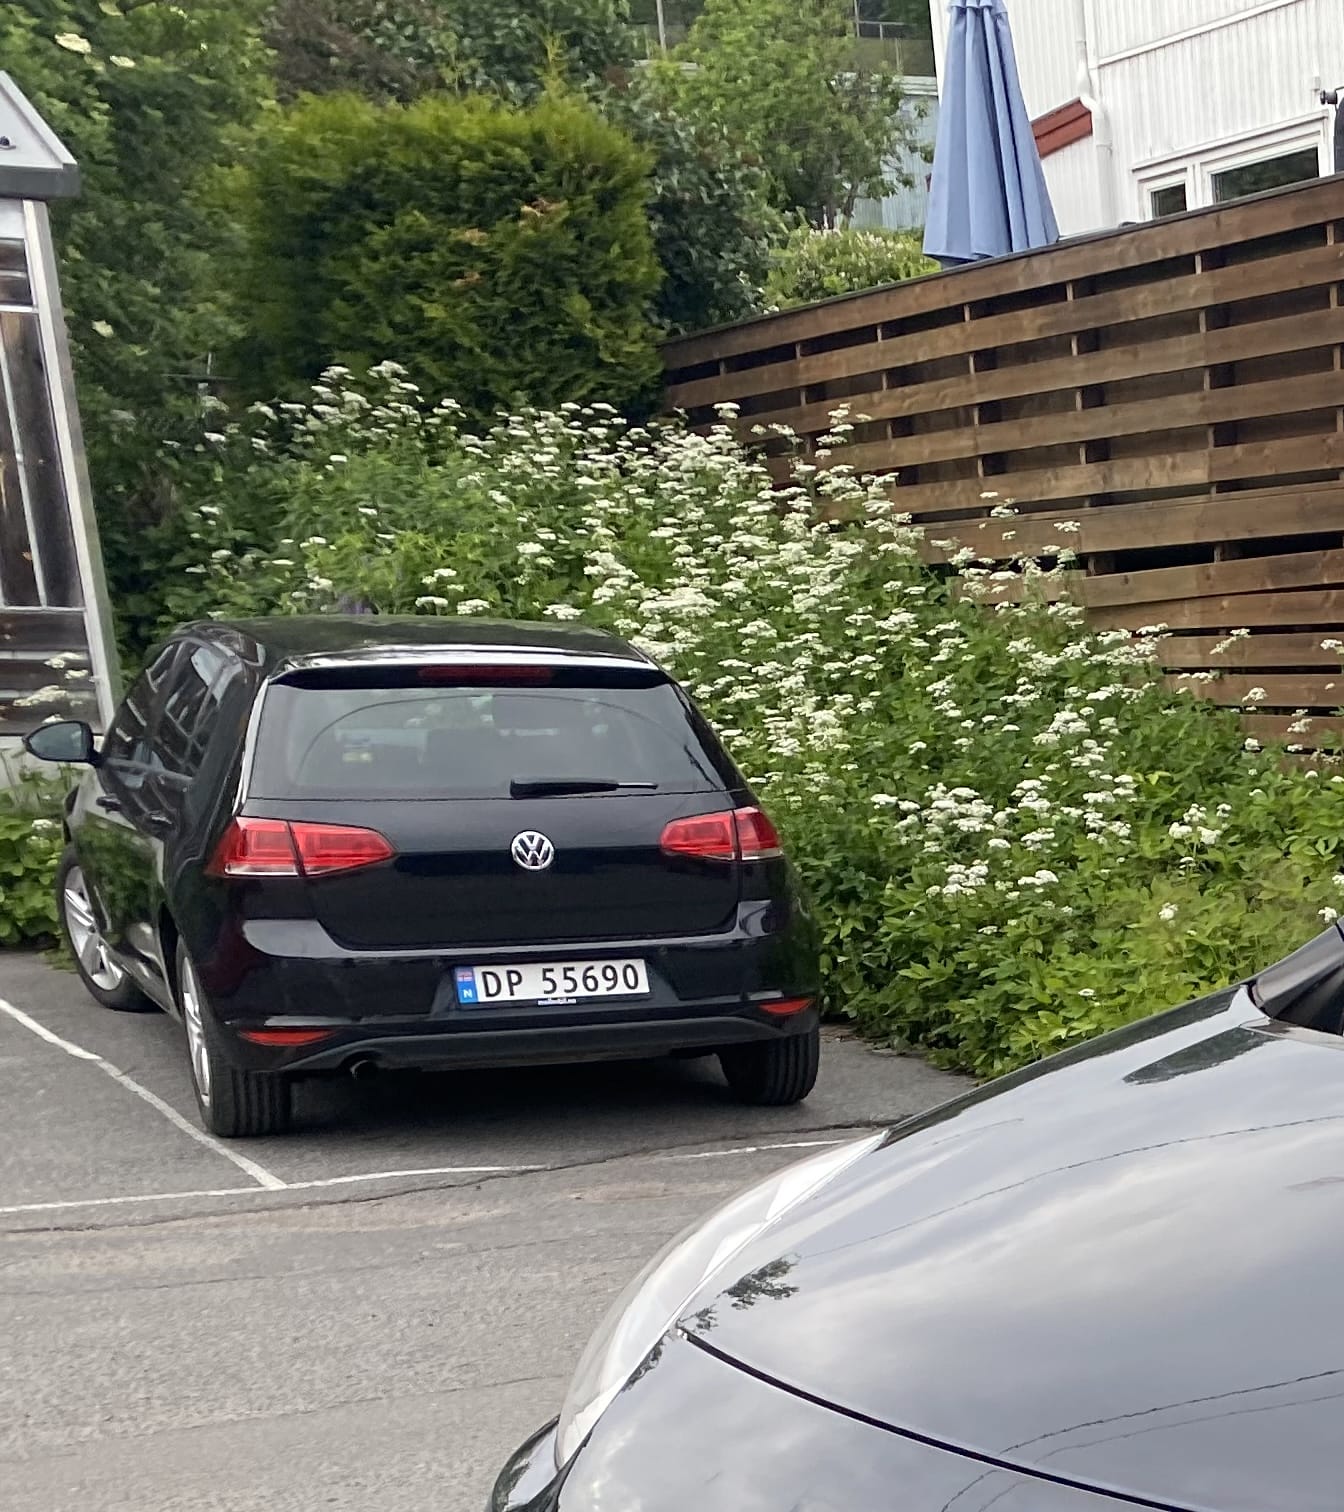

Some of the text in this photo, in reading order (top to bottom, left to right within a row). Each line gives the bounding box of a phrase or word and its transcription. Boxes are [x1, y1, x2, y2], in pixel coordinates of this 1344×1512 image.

[482, 963, 640, 997] DP 55690
[463, 989, 473, 999] N
